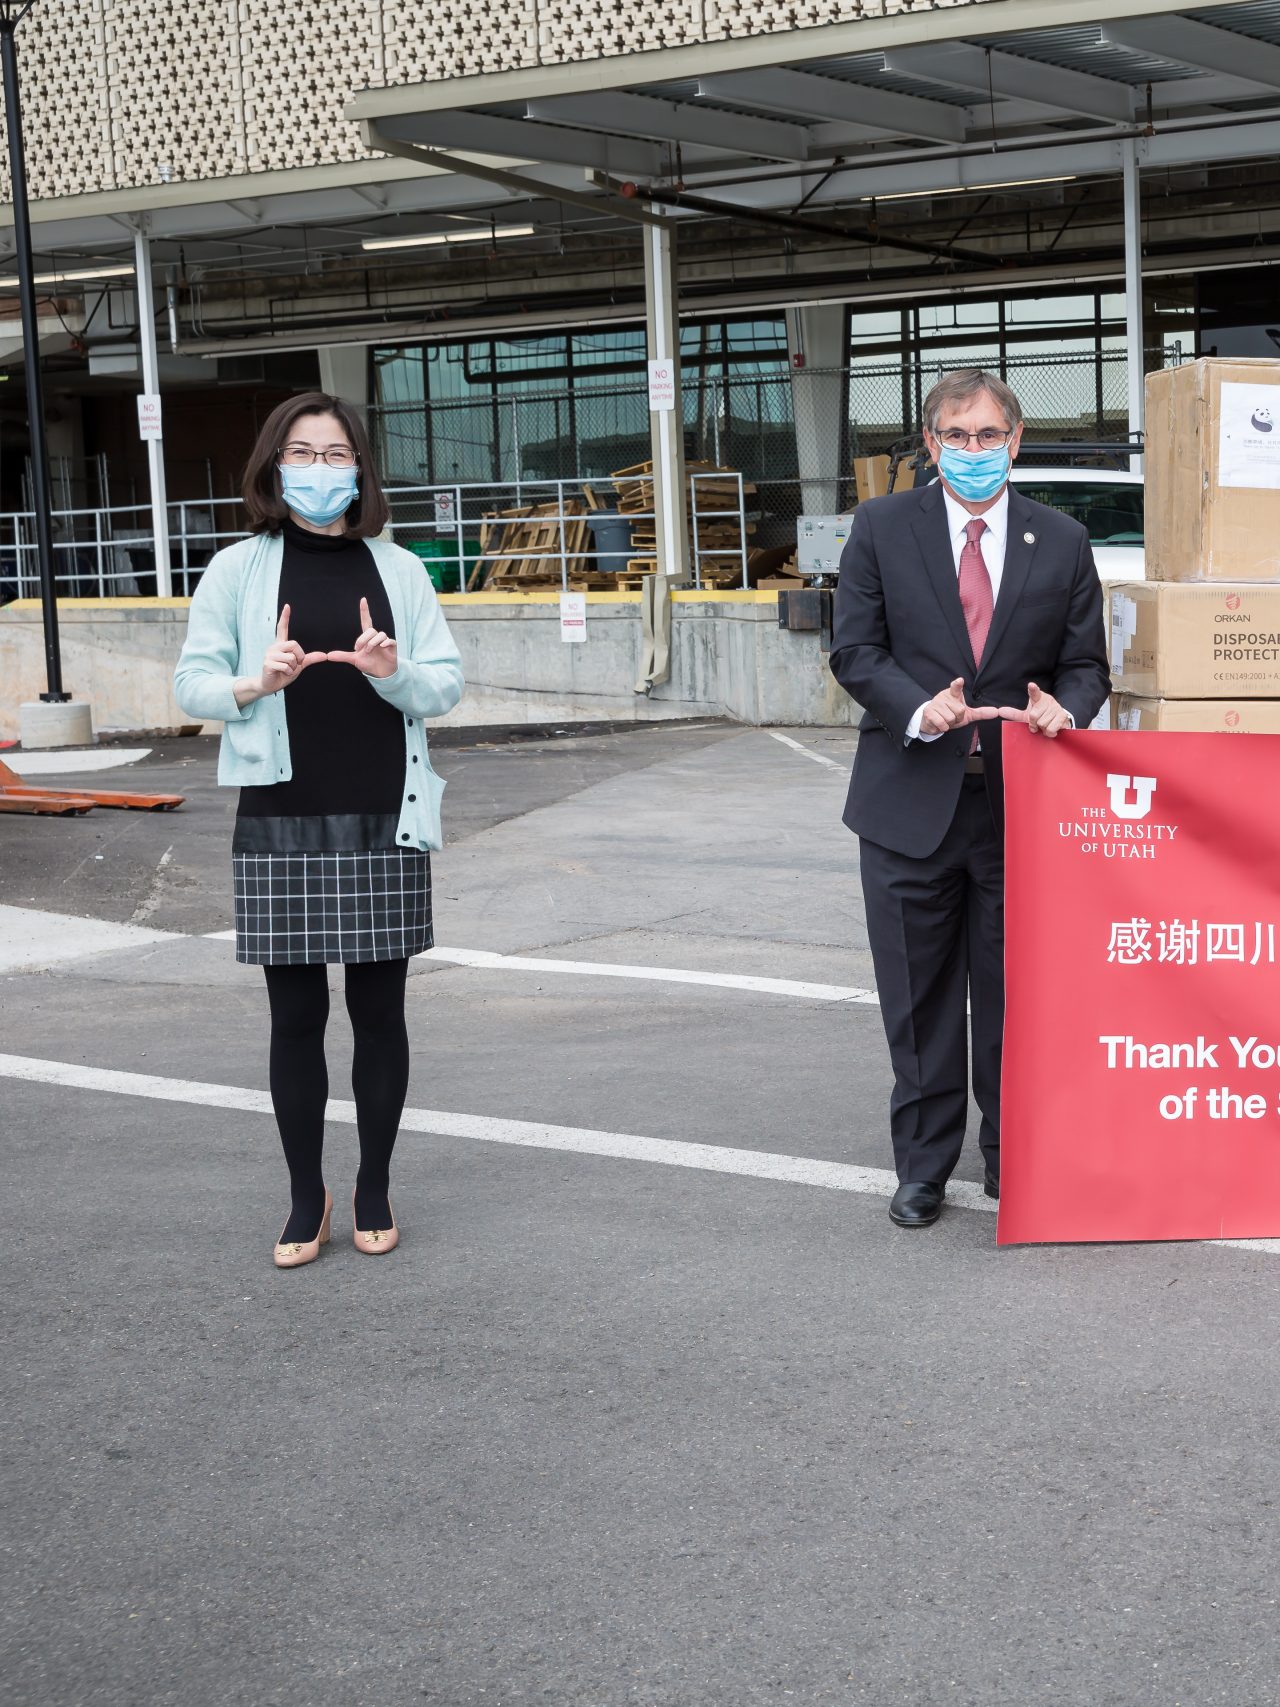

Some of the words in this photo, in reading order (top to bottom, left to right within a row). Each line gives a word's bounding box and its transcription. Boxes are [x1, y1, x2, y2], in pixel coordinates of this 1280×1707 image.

[655, 370, 667, 379] NO
[144, 404, 154, 412] NO
[1214, 614, 1251, 623] ORKAN
[1225, 672, 1266, 680] EN149:2001
[1106, 773, 1157, 820] U
[1081, 807, 1106, 818] THE
[1059, 822, 1178, 840] UNIVERSITY
[1081, 842, 1098, 853] OF
[1103, 843, 1156, 859] UTAH
[1099, 1035, 1219, 1069] Thank
[1159, 1087, 1198, 1120] of
[1206, 1087, 1267, 1119] the
